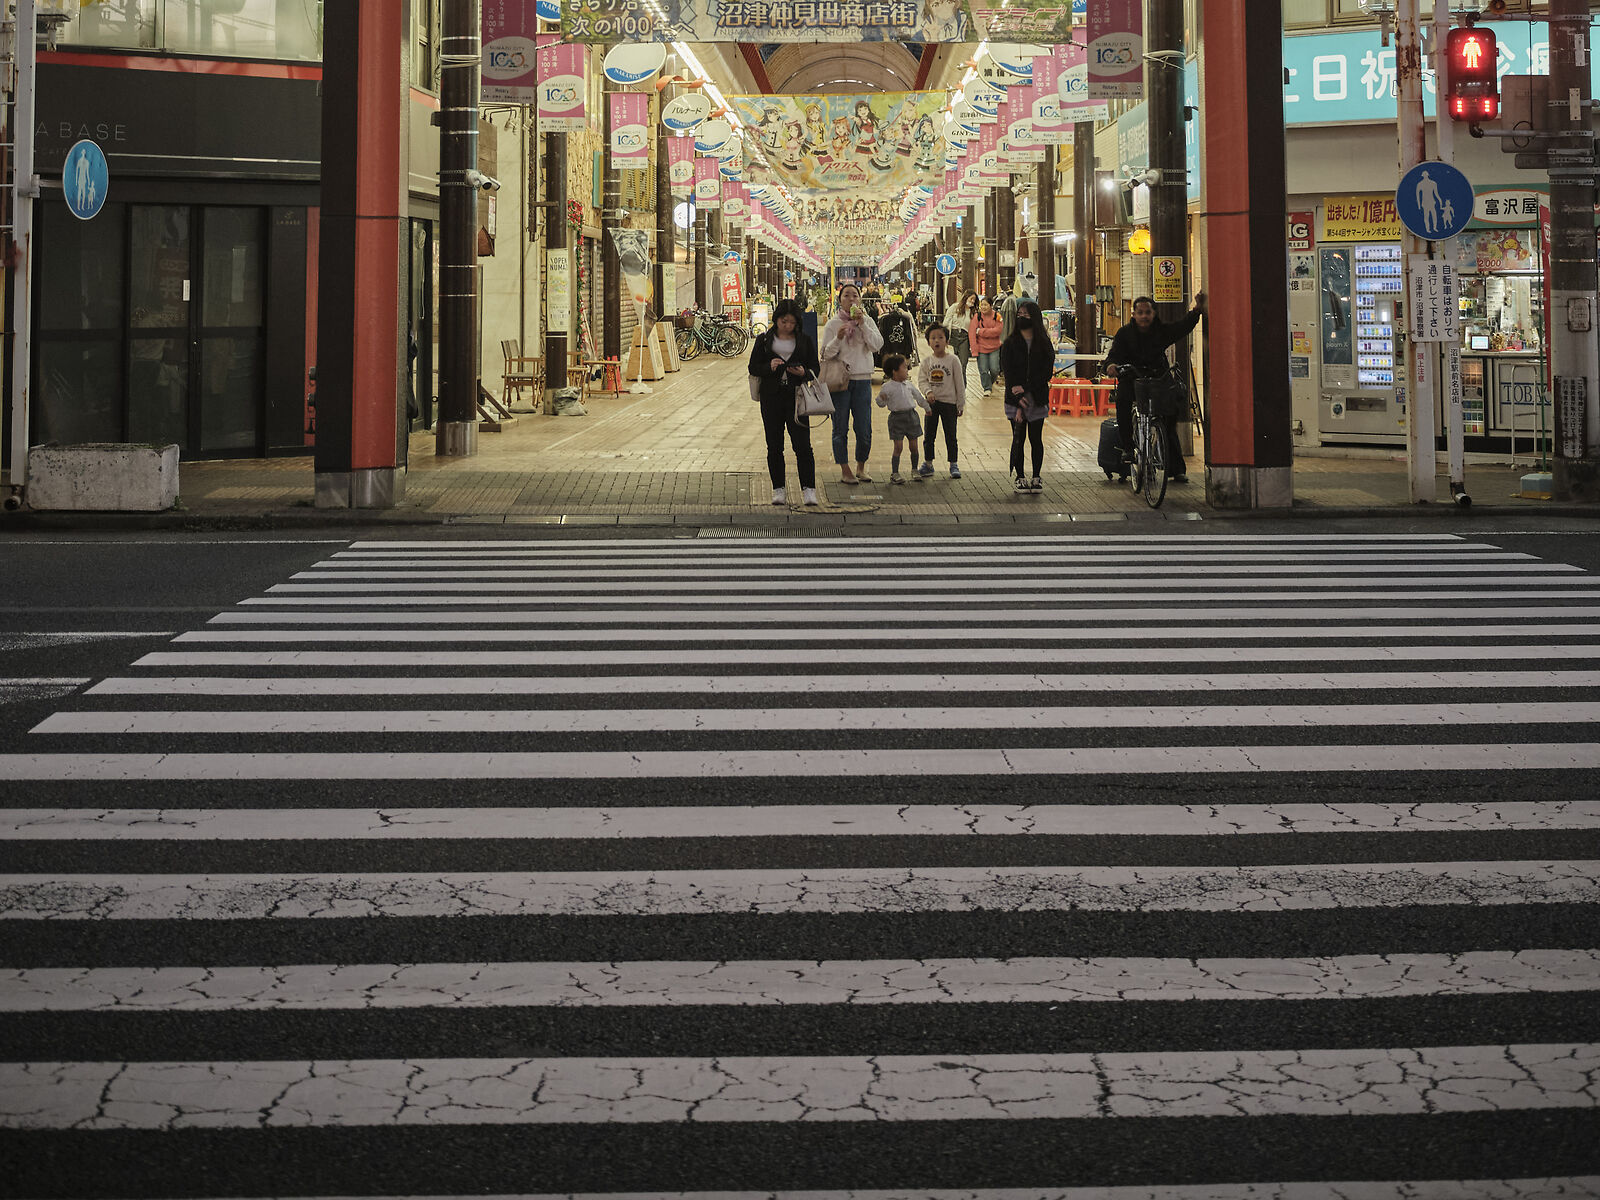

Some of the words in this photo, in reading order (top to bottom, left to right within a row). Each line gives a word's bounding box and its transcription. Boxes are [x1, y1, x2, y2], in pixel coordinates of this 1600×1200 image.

[718, 2, 917, 28] 沼津仲見世商店街
[60, 121, 127, 141] BASE
[1327, 204, 1361, 221] 出ました!
[1485, 197, 1538, 215] 富沢屋
[1415, 276, 1425, 338] 沼津市・沼津警察署
[1428, 264, 1439, 338] 通行して下さい
[1442, 264, 1453, 338] 自転車はおりて
[1417, 352, 1425, 383] 頭上注意
[1450, 348, 1460, 404] 沼津駅前名店街
